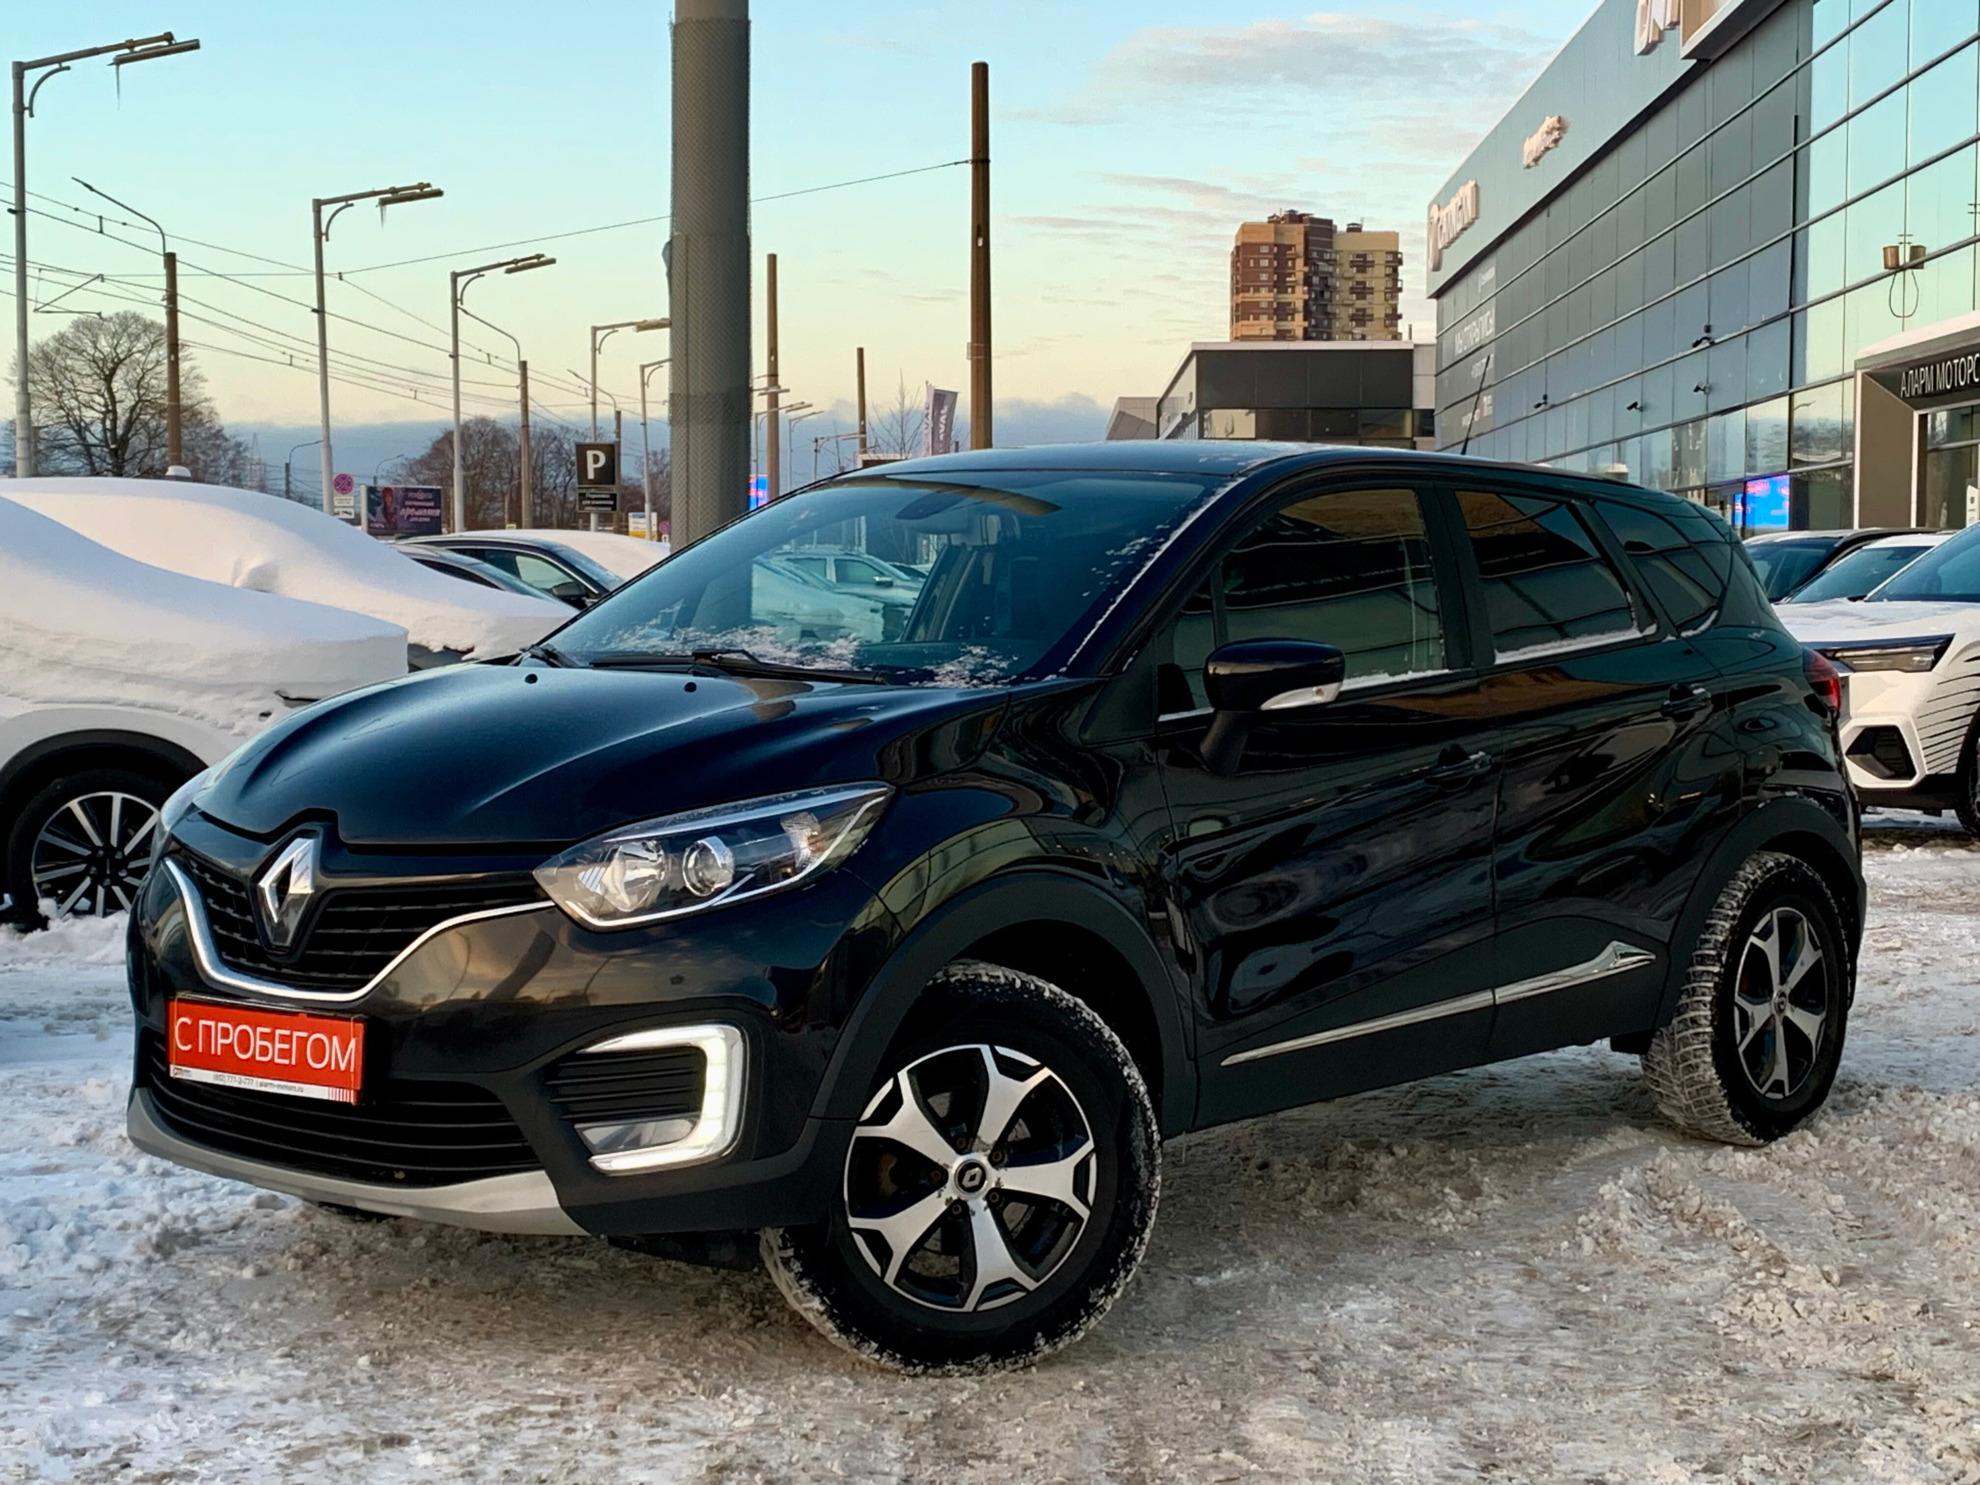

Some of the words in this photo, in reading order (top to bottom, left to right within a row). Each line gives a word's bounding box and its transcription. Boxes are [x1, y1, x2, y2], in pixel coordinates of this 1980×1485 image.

[1900, 364, 1934, 398] АЛАРМ
[1936, 353, 1980, 391] МОТОРС
[586, 450, 607, 480] P
[174, 1017, 193, 1051] С
[198, 1019, 356, 1073] ПРОБЕГОМ
